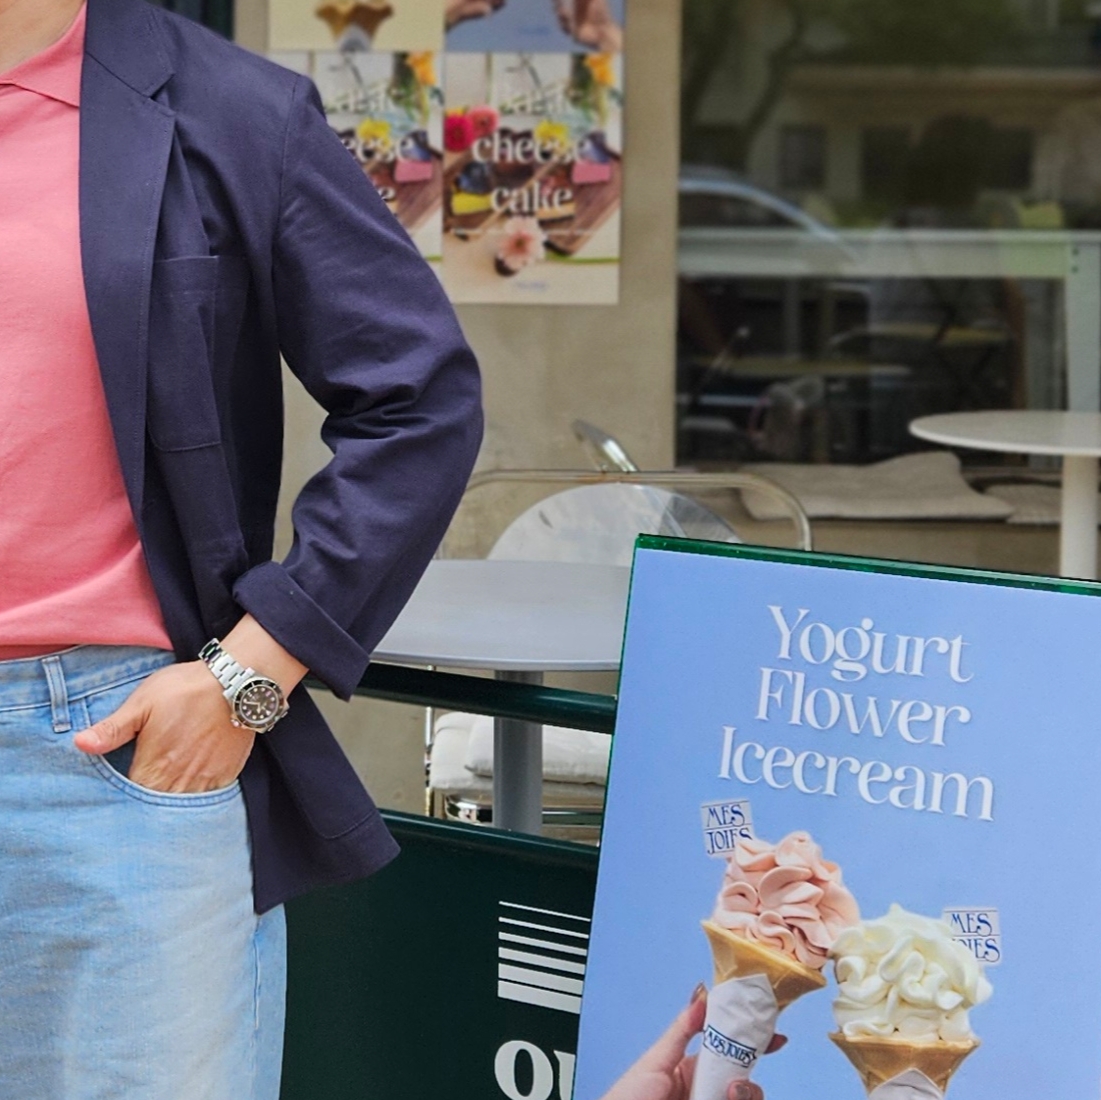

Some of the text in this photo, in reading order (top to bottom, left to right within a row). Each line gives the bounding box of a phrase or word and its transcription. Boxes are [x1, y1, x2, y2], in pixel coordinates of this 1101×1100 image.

[471, 130, 586, 165] cheese
[490, 181, 573, 213] cake
[767, 605, 974, 683] Yogurt
[756, 667, 971, 747] Flower
[717, 726, 995, 822] Icecream
[706, 804, 746, 828] MES
[950, 912, 993, 937] MES
